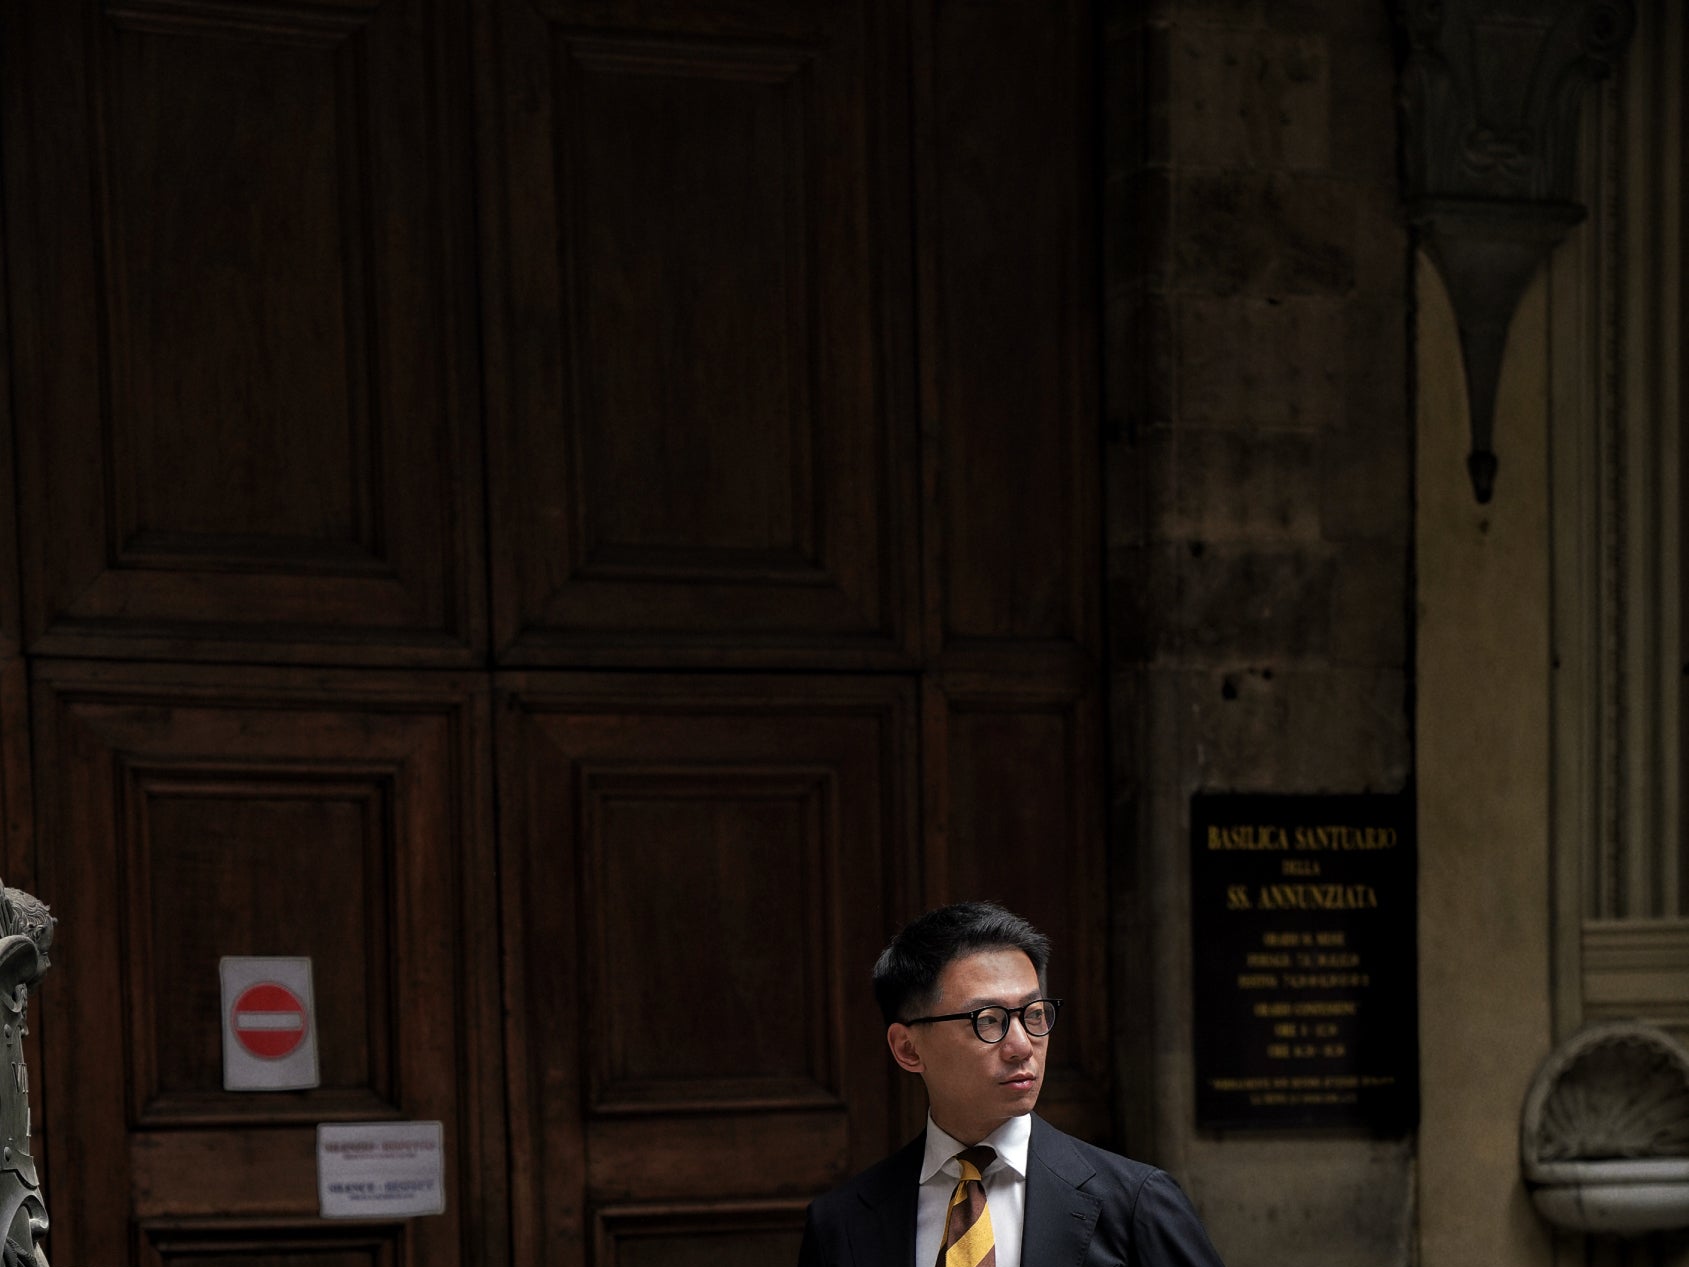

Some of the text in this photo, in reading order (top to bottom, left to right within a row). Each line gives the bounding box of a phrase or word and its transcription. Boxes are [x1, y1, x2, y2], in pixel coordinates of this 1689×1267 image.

[1207, 824, 1397, 851] BASILICA SANTUARIO
[1258, 883, 1378, 910] ANNUNZIATA
